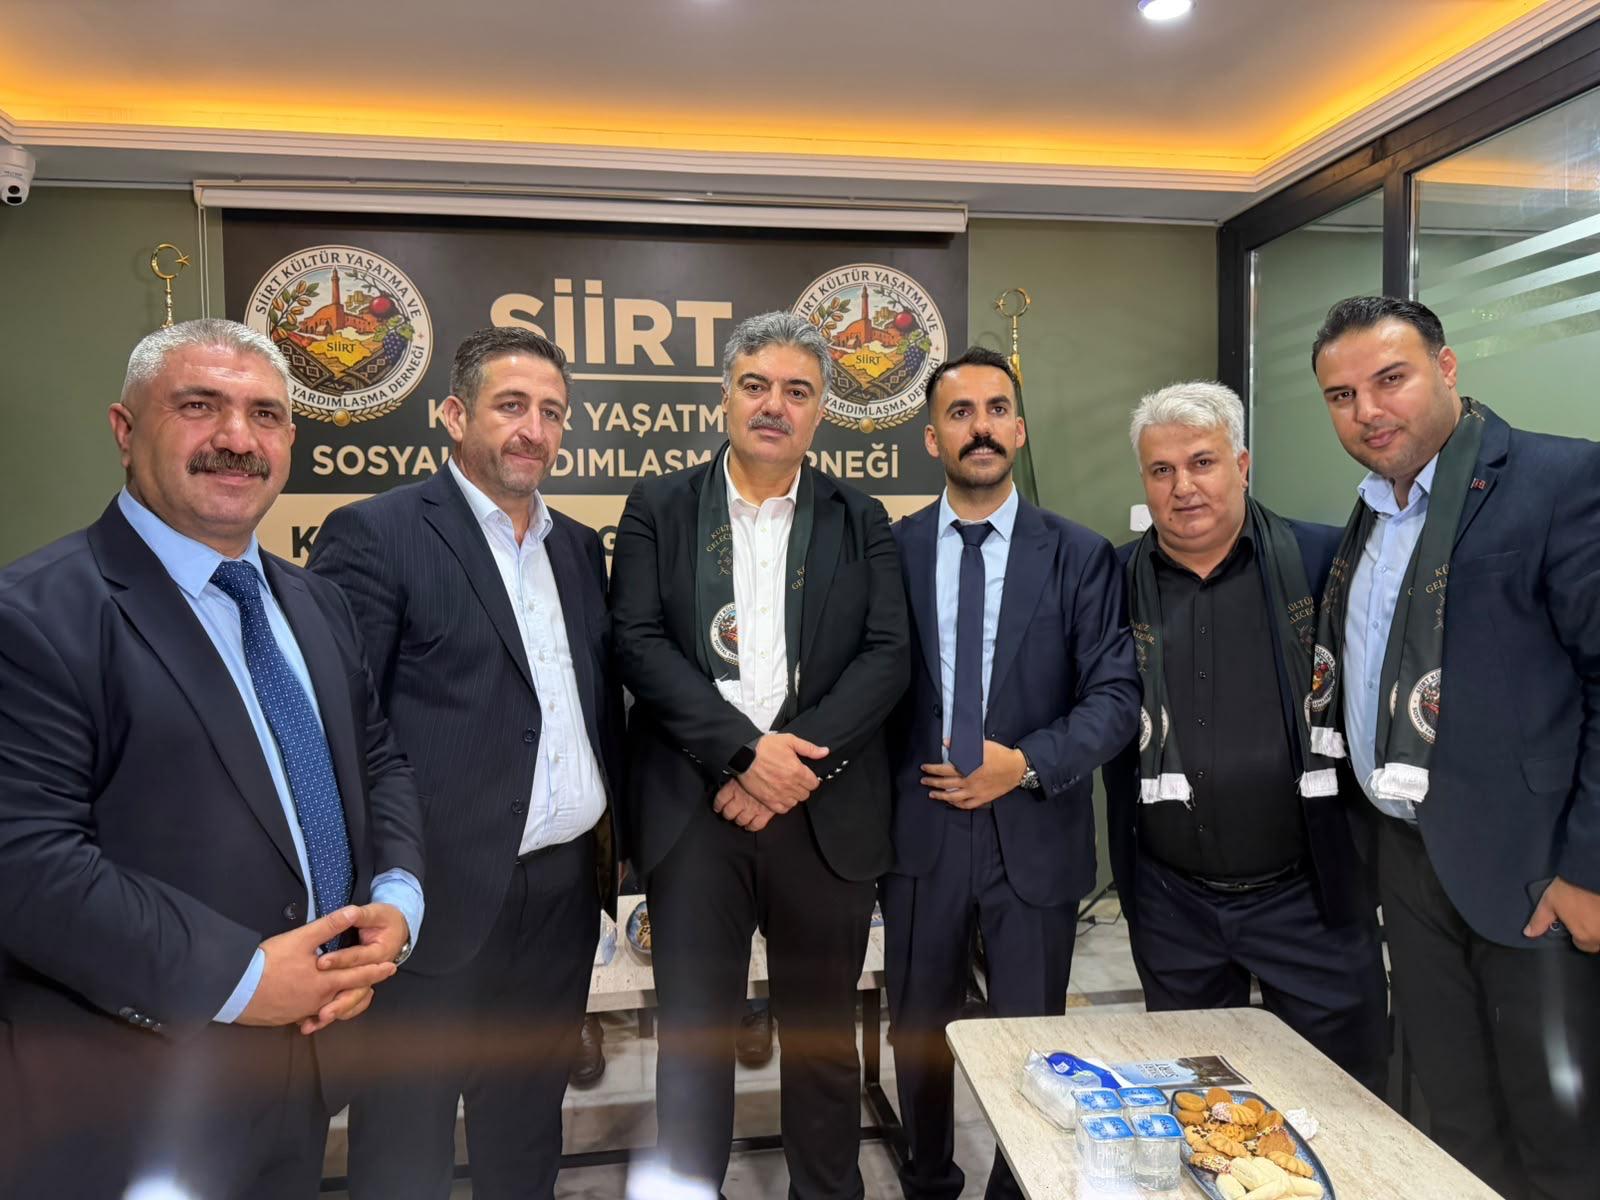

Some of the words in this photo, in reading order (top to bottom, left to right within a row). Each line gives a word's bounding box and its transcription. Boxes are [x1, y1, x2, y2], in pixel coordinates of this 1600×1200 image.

[281, 250, 341, 279] KÜLTÜR
[346, 252, 409, 298] YAŞATMA
[407, 298, 422, 319] VE
[818, 268, 870, 295] KÜLTÜR
[875, 271, 928, 313] YAŞATMA
[926, 313, 939, 332] VE
[292, 385, 388, 408] YARDIMLAŞMA
[388, 345, 425, 394] DERNEĞİ
[584, 402, 728, 438] YAŞATM
